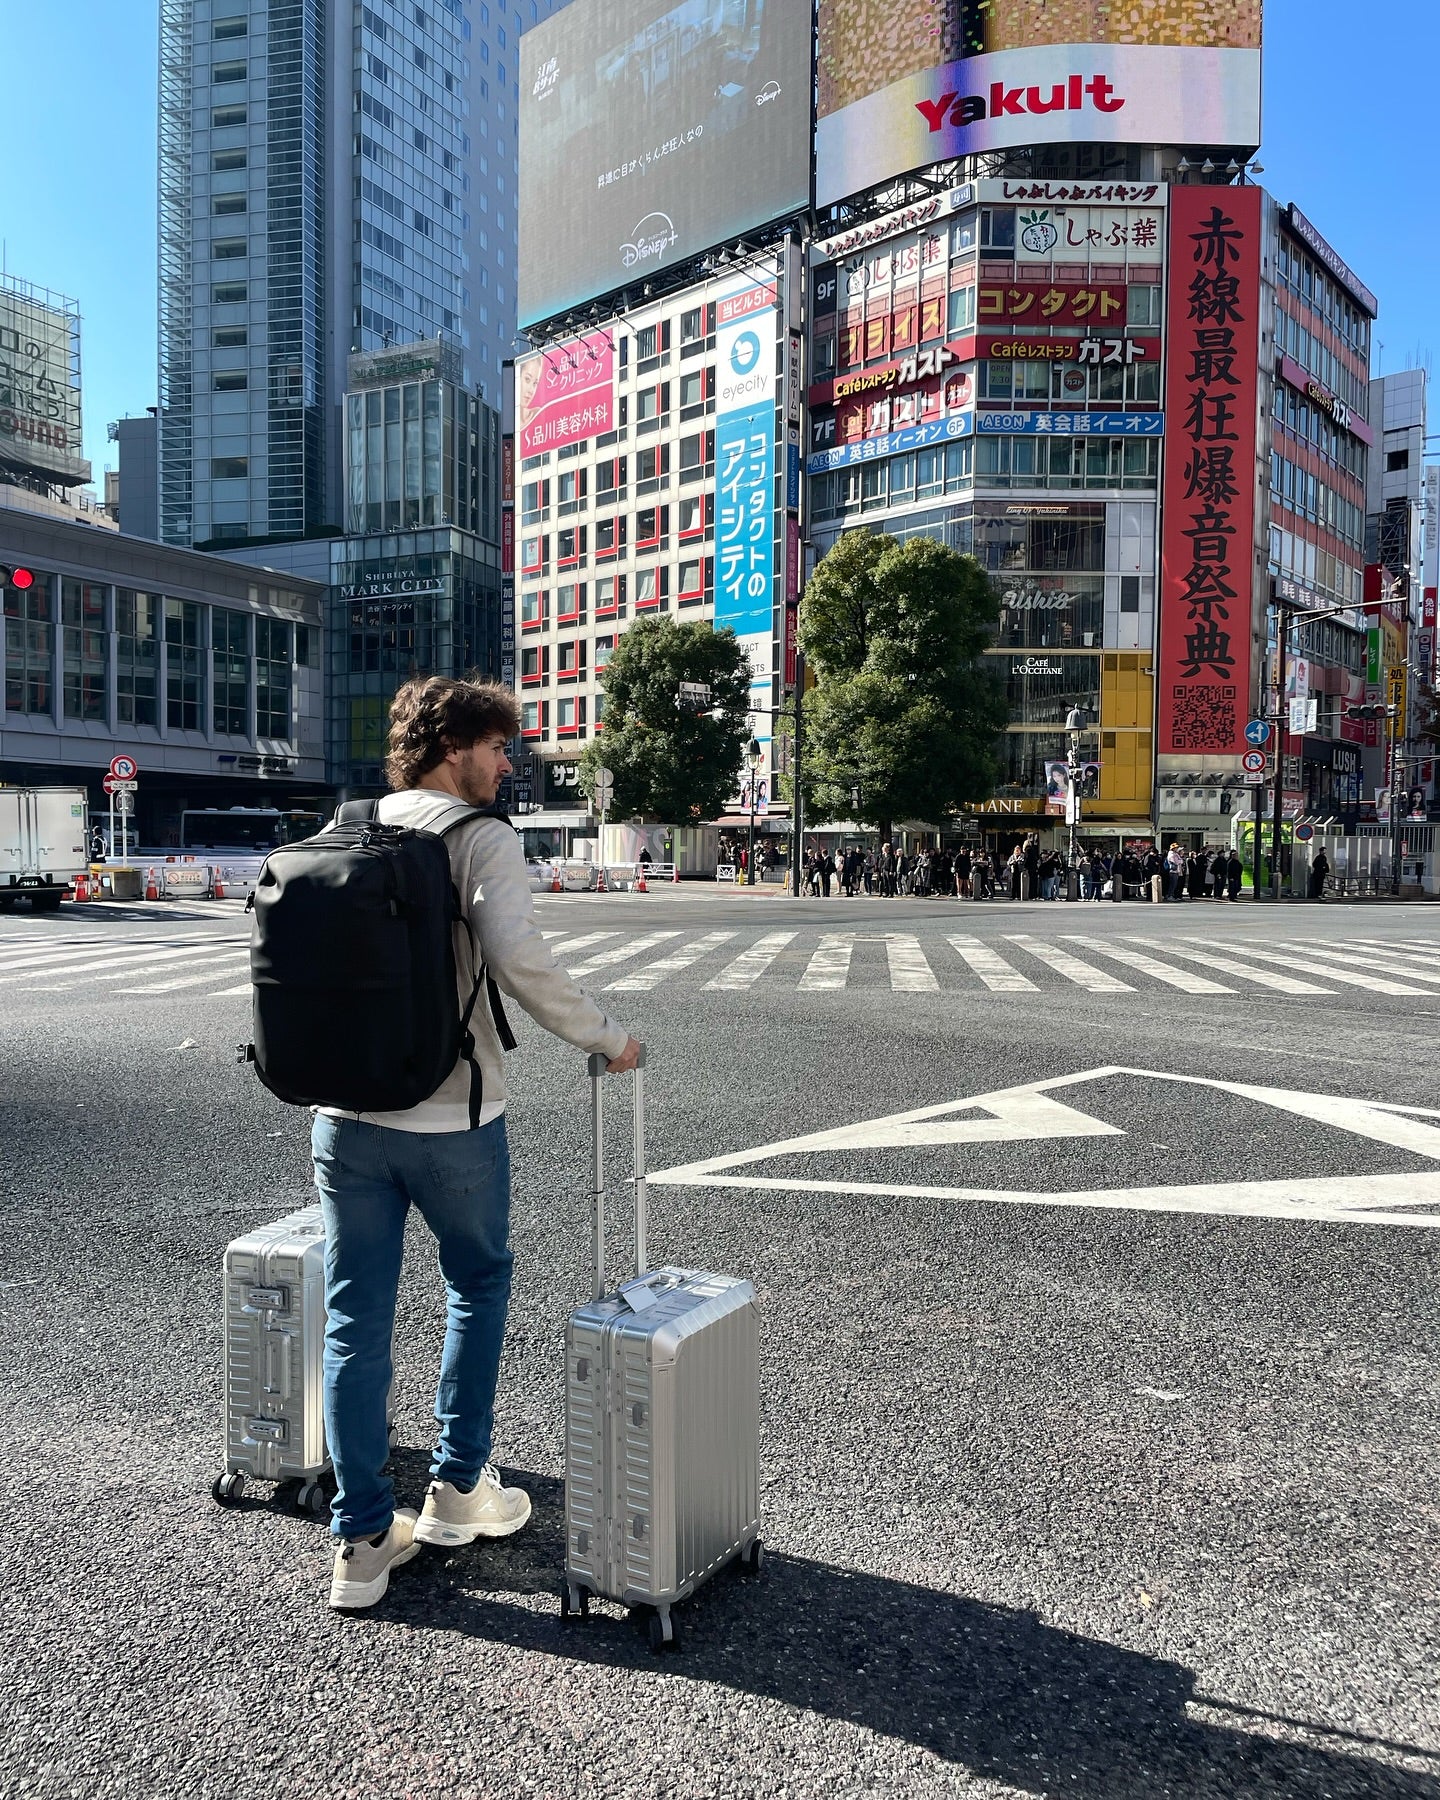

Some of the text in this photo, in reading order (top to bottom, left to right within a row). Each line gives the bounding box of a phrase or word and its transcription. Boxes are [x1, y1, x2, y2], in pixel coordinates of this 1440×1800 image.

[915, 75, 1125, 133] Yakult
[1003, 182, 1159, 201] しゃぶしゃぶバイキング
[1066, 218, 1157, 248] しゃぶ葉
[817, 279, 836, 300] 9F
[980, 288, 1121, 317] コンタクト
[722, 289, 770, 319] 当ビル5F
[1078, 337, 1145, 364] ガスト
[560, 362, 603, 391] クリニック
[898, 349, 952, 385] ガスト
[722, 374, 768, 402] eyecity
[532, 402, 608, 446] 品川美容外科
[814, 418, 835, 442] 7F
[982, 414, 1160, 432] AEON 英会話イーオン
[811, 451, 840, 470] AEON
[850, 425, 942, 462] 英会話イーオン
[1177, 206, 1246, 679] 赤線最狂爆音祭典
[721, 438, 746, 600] アイシティ
[748, 433, 766, 597] コンタクトの
[340, 577, 445, 597] MARK CITY
[365, 570, 415, 581] SHIBUYA
[524, 766, 532, 776] 2F
[1332, 749, 1357, 773] LUSH
[552, 765, 580, 787] サン
